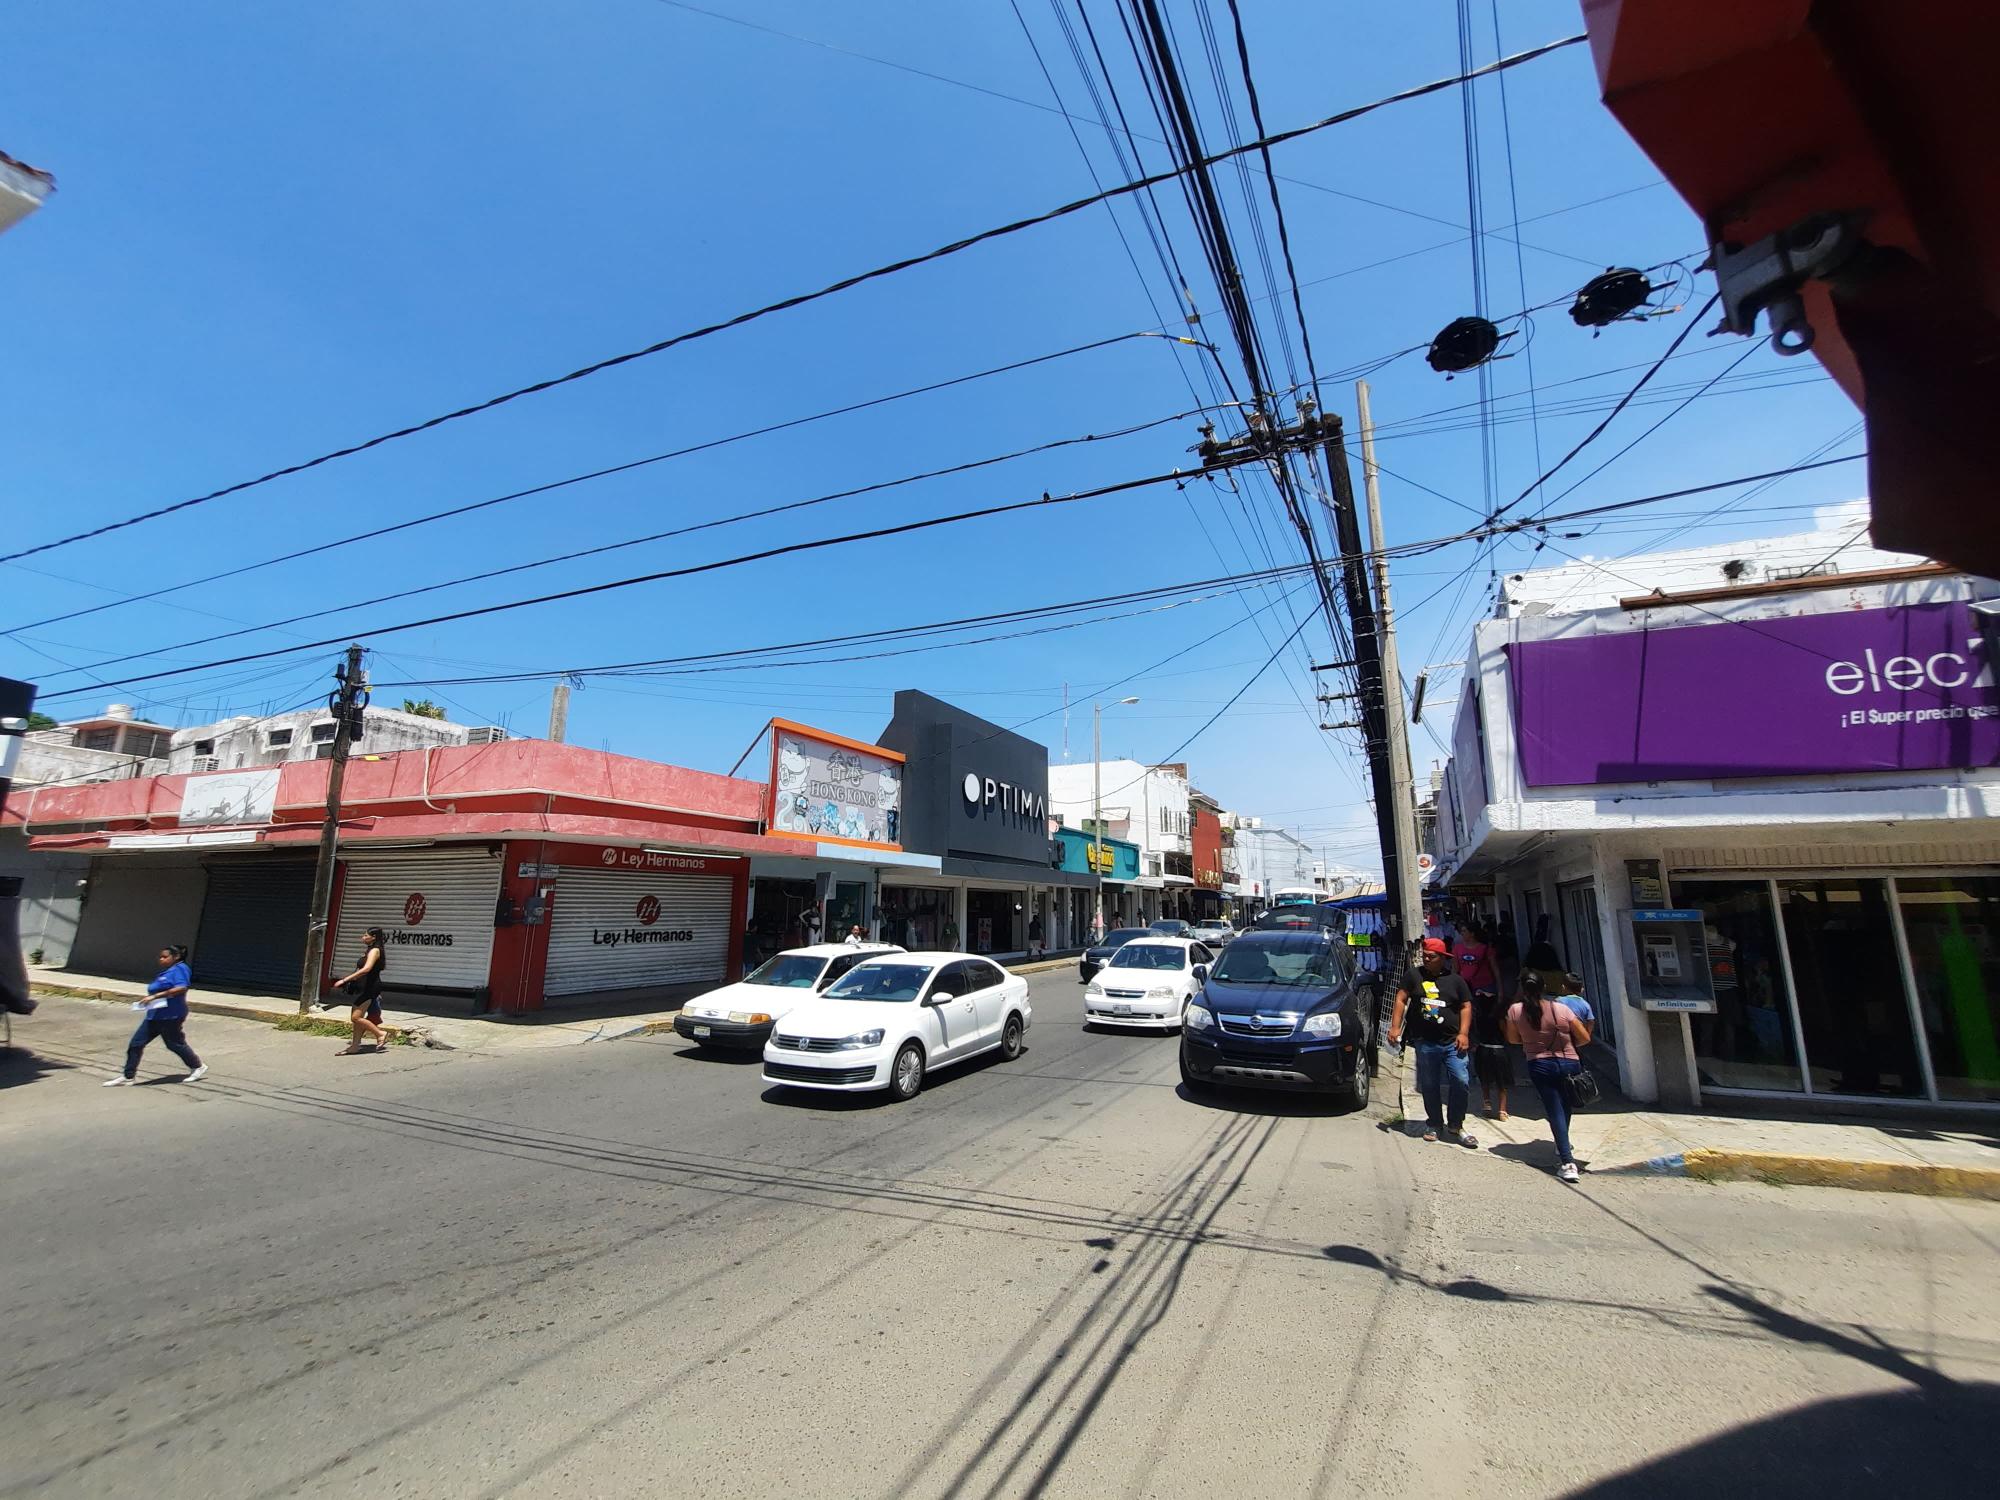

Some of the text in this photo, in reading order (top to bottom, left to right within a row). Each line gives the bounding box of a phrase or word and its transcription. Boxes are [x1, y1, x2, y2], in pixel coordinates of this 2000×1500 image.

[1916, 704, 1963, 724] precio
[826, 750, 862, 786] 香港
[810, 780, 845, 803] HONG
[846, 787, 877, 808] KONG
[964, 773, 1045, 821] OPTIMA
[621, 850, 644, 868] Ley
[647, 853, 705, 868] Hermanos
[392, 929, 453, 946] Hermanos
[593, 928, 694, 948] Ley Hermanos
